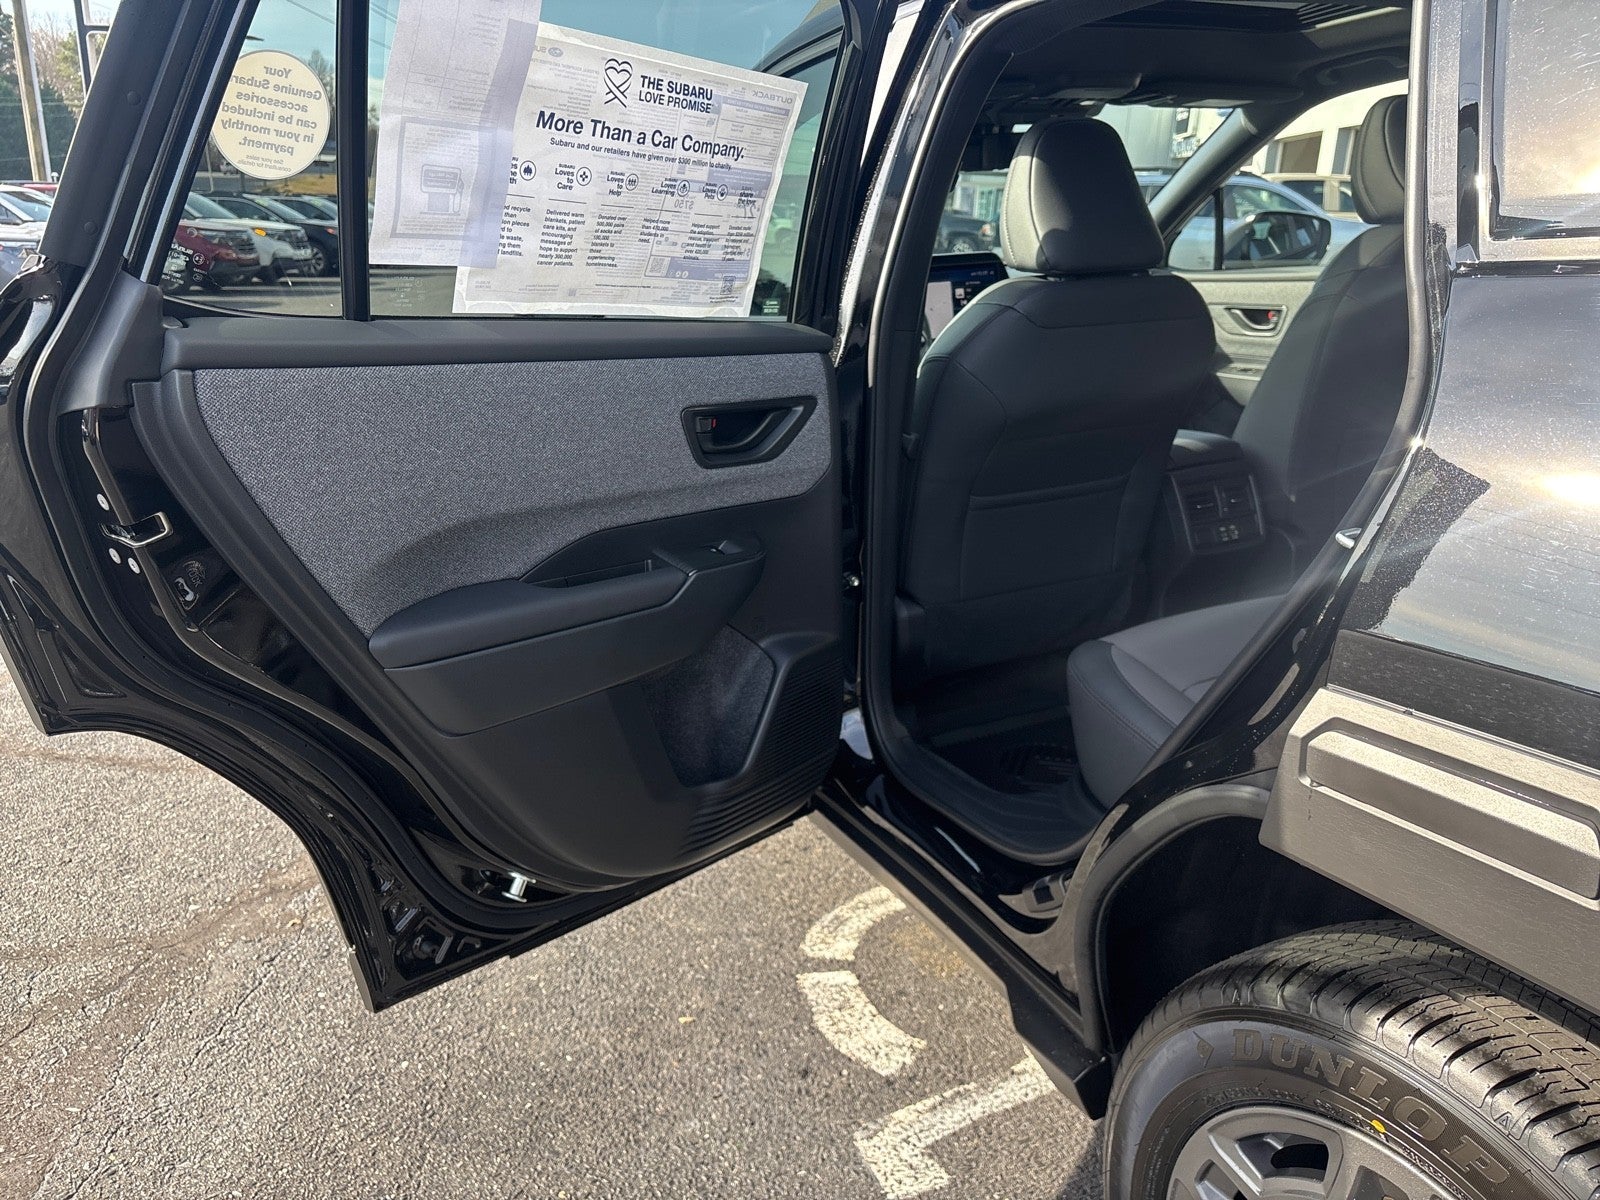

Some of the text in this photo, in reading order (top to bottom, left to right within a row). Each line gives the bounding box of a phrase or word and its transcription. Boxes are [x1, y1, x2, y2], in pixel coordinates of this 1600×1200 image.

[640, 75, 664, 91] THE
[667, 80, 713, 101] SUBARU
[638, 90, 664, 106] LOVE
[667, 96, 712, 114] PROMISE
[536, 110, 745, 162] More Than a Car Company.
[550, 137, 575, 148] Subaru
[604, 146, 630, 157] retailers
[632, 151, 646, 159] have
[648, 153, 663, 161] given
[555, 168, 574, 177] Loves
[607, 175, 624, 184] Loves
[557, 182, 573, 190] Care
[661, 181, 676, 189] Loves
[609, 189, 621, 197] Help
[652, 187, 675, 197] Learning
[541, 231, 573, 240] encouraging
[1232, 1028, 1510, 1184] DUNLOP
